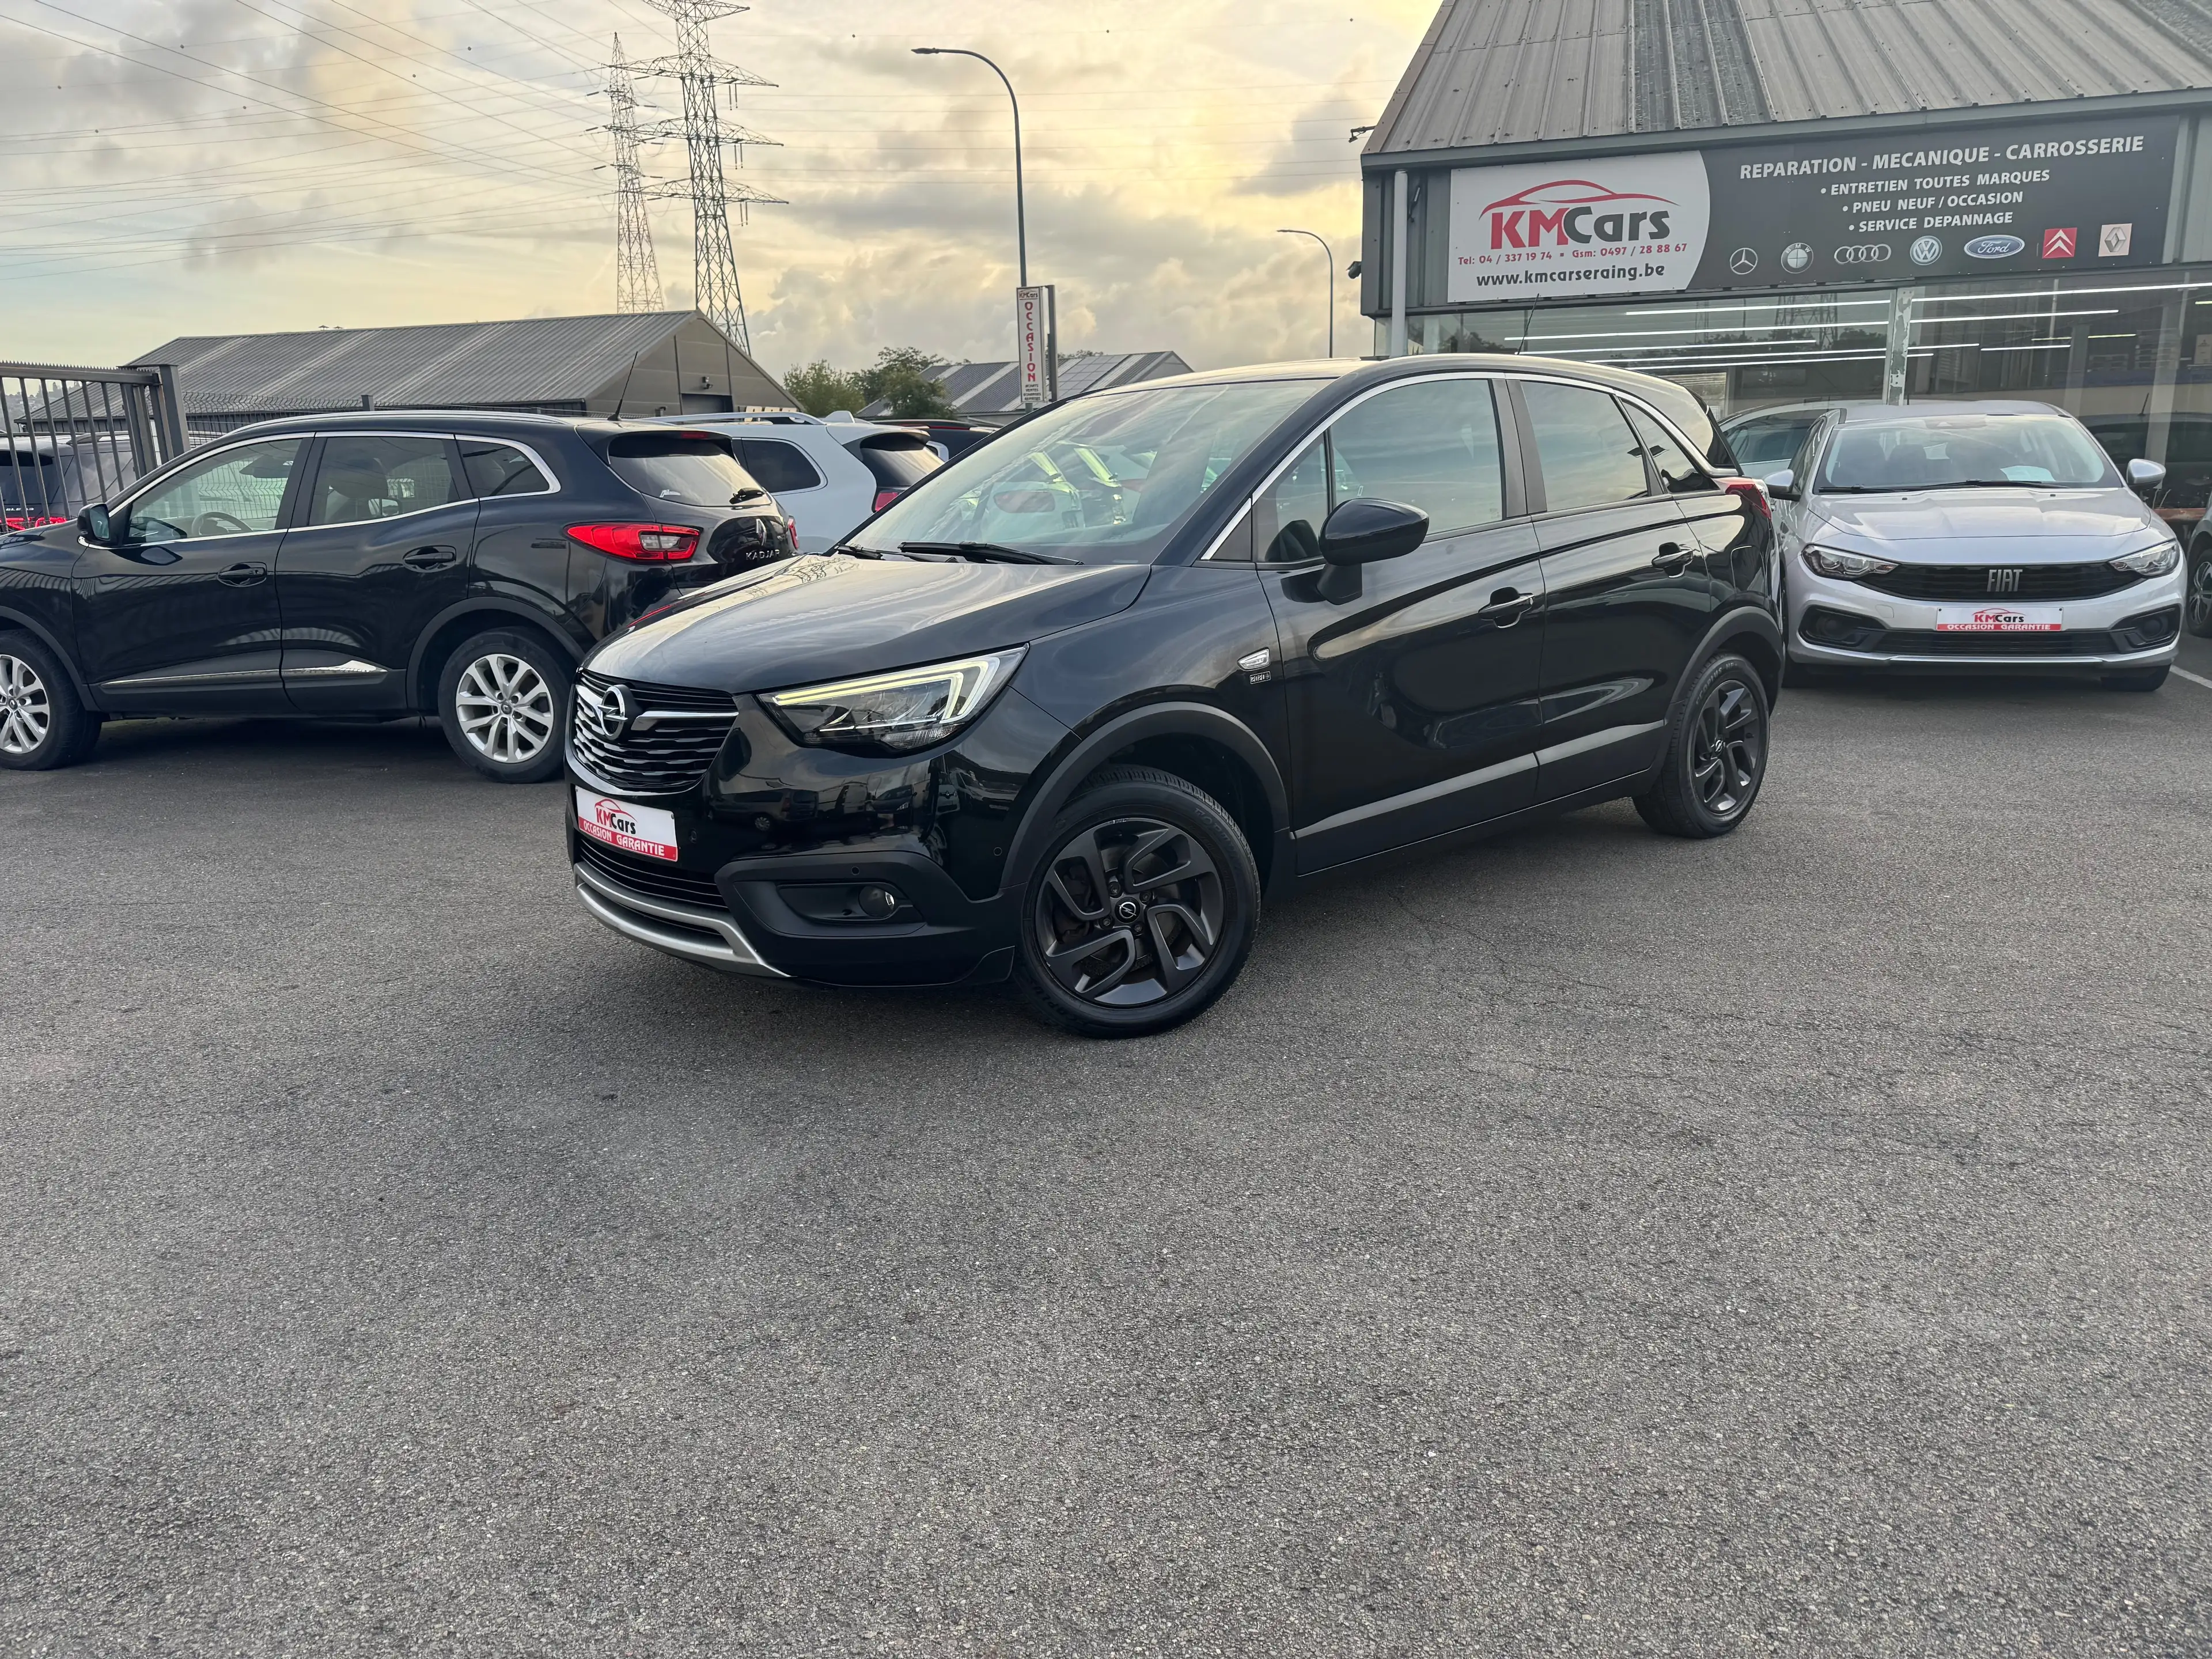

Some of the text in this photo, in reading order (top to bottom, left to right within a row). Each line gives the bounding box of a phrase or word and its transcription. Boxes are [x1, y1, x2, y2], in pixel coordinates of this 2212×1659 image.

[1740, 156, 1857, 179] REPARATION
[1872, 146, 1990, 169] MECANIQUE
[2006, 135, 2144, 160] CARROSSERIE
[1831, 169, 2050, 195] ENTRETIEN TOUTES MARQUES
[1853, 199, 1891, 213] PNEU
[1897, 197, 1936, 210] NEUF
[1947, 191, 2023, 207] OCCASION
[1490, 206, 1671, 250] KMCars
[1859, 211, 2013, 232] SERVICE DEPANNAGE
[1457, 256, 1475, 266] Tel:
[1479, 255, 1493, 264] 04
[1505, 253, 1522, 262] 337
[1525, 252, 1537, 261] 19
[1540, 251, 1552, 260] 74
[1572, 249, 1596, 258] Gsm:
[1600, 247, 1627, 257] 0497
[1639, 245, 1652, 254] 28
[1657, 244, 1670, 253] 88
[1675, 243, 1687, 252] 67
[1977, 240, 2012, 254] Ford
[1476, 263, 1665, 286] www.kmcarseraing.be
[1024, 301, 1036, 382] OCCASION
[1987, 569, 2023, 592] FIAT
[1974, 614, 2025, 623] KMCars
[596, 807, 637, 835] KMCars
[583, 820, 665, 857] OCCASION GARANTIE
